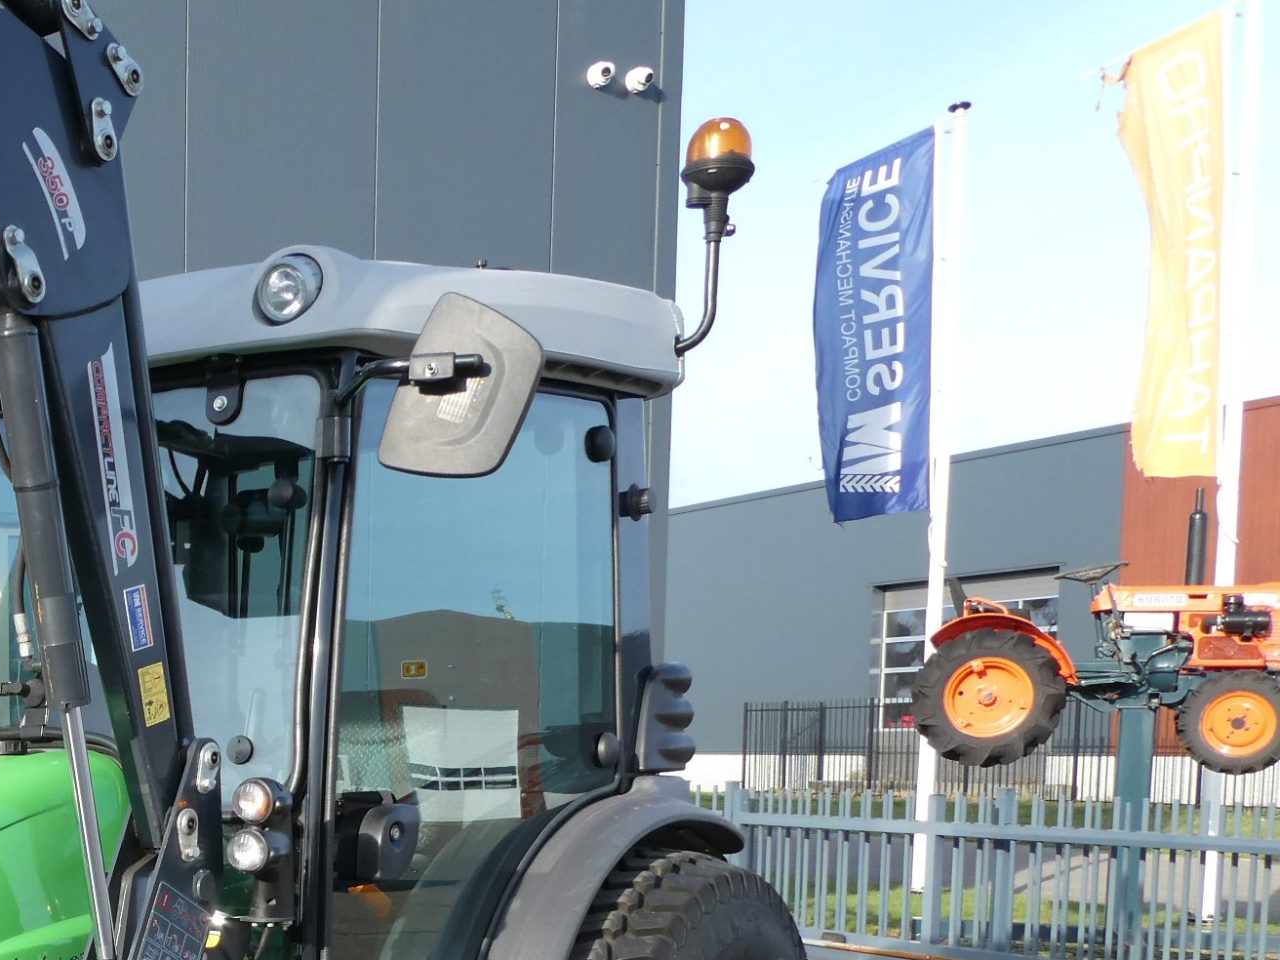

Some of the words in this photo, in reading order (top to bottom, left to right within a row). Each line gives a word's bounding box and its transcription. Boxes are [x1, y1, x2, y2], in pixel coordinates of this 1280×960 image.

[37, 156, 70, 211] 350
[61, 217, 75, 233] P
[111, 505, 138, 559] FC
